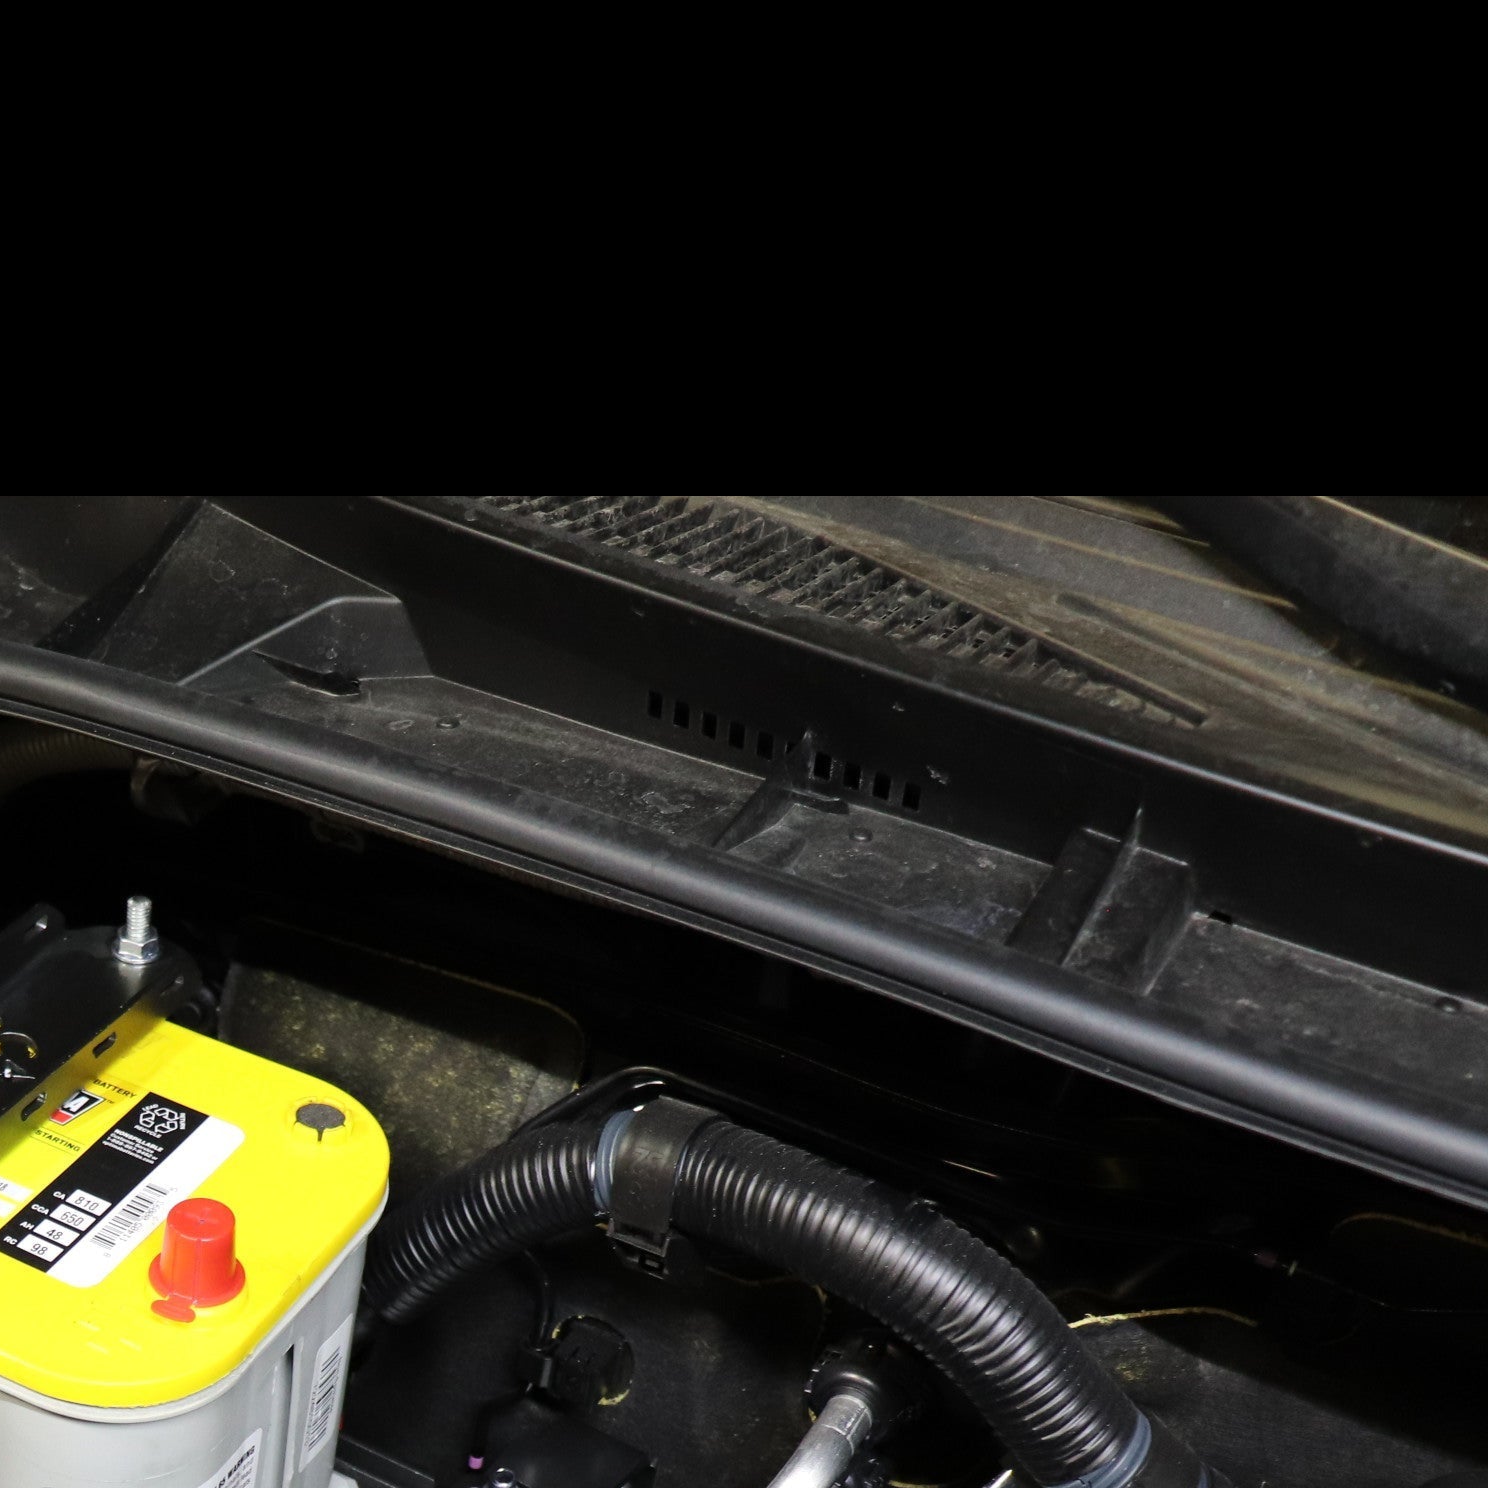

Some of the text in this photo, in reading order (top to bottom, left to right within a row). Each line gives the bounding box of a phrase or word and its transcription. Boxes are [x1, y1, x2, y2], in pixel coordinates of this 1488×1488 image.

[92, 1079, 137, 1098] BATTERY
[35, 1129, 81, 1152] STARTING
[113, 1128, 165, 1153] NONSPILLABLE
[133, 1124, 163, 1139] RECYCLE
[53, 1191, 99, 1212] CA 810
[31, 1203, 84, 1227] CCA 650
[20, 1221, 63, 1241] AH 48
[3, 1236, 48, 1256] RC 98
